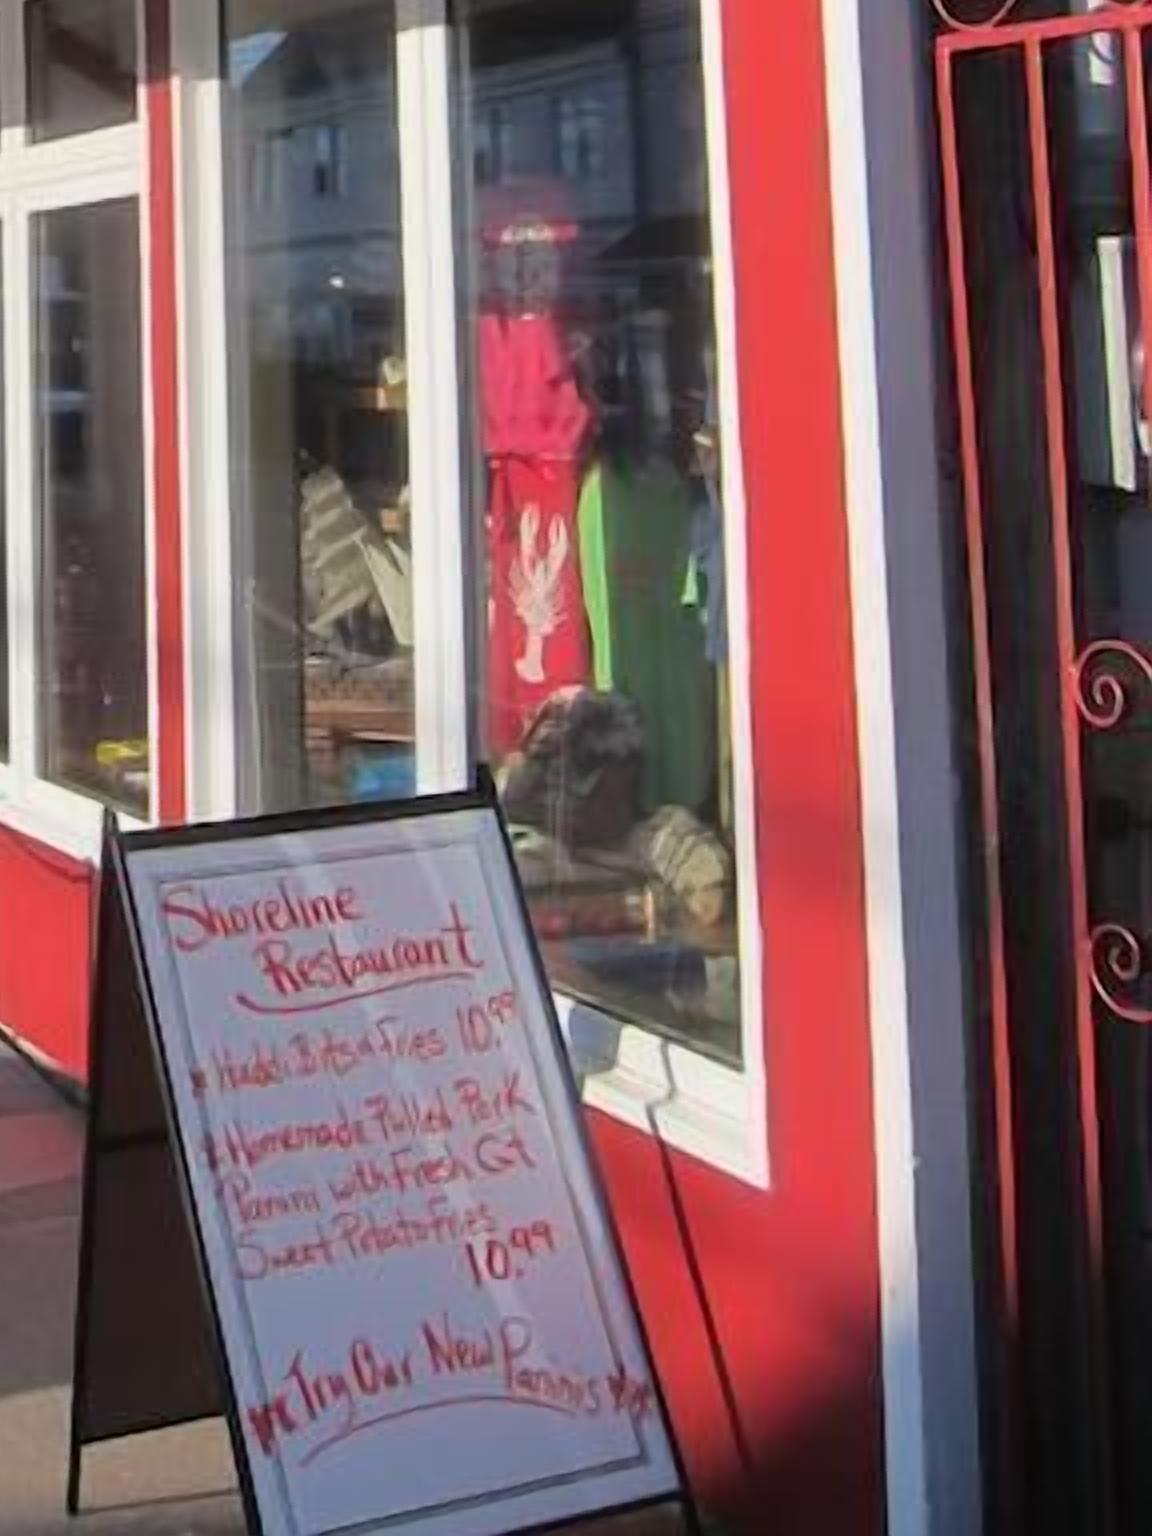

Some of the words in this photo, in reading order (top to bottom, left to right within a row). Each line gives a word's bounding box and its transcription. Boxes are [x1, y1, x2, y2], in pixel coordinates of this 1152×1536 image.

[160, 876, 366, 952] Shoreline
[256, 901, 486, 995] Restaurant
[225, 1099, 365, 1167] Homemade
[363, 1087, 452, 1142] Pulled
[455, 1070, 535, 1122] Pork
[328, 1161, 388, 1204] with
[389, 1132, 475, 1194] Fresh
[234, 1221, 335, 1280] Sweet
[464, 1218, 556, 1288] 10.99
[284, 1348, 355, 1424] Try
[352, 1337, 416, 1396] Our
[420, 1313, 494, 1375] New
